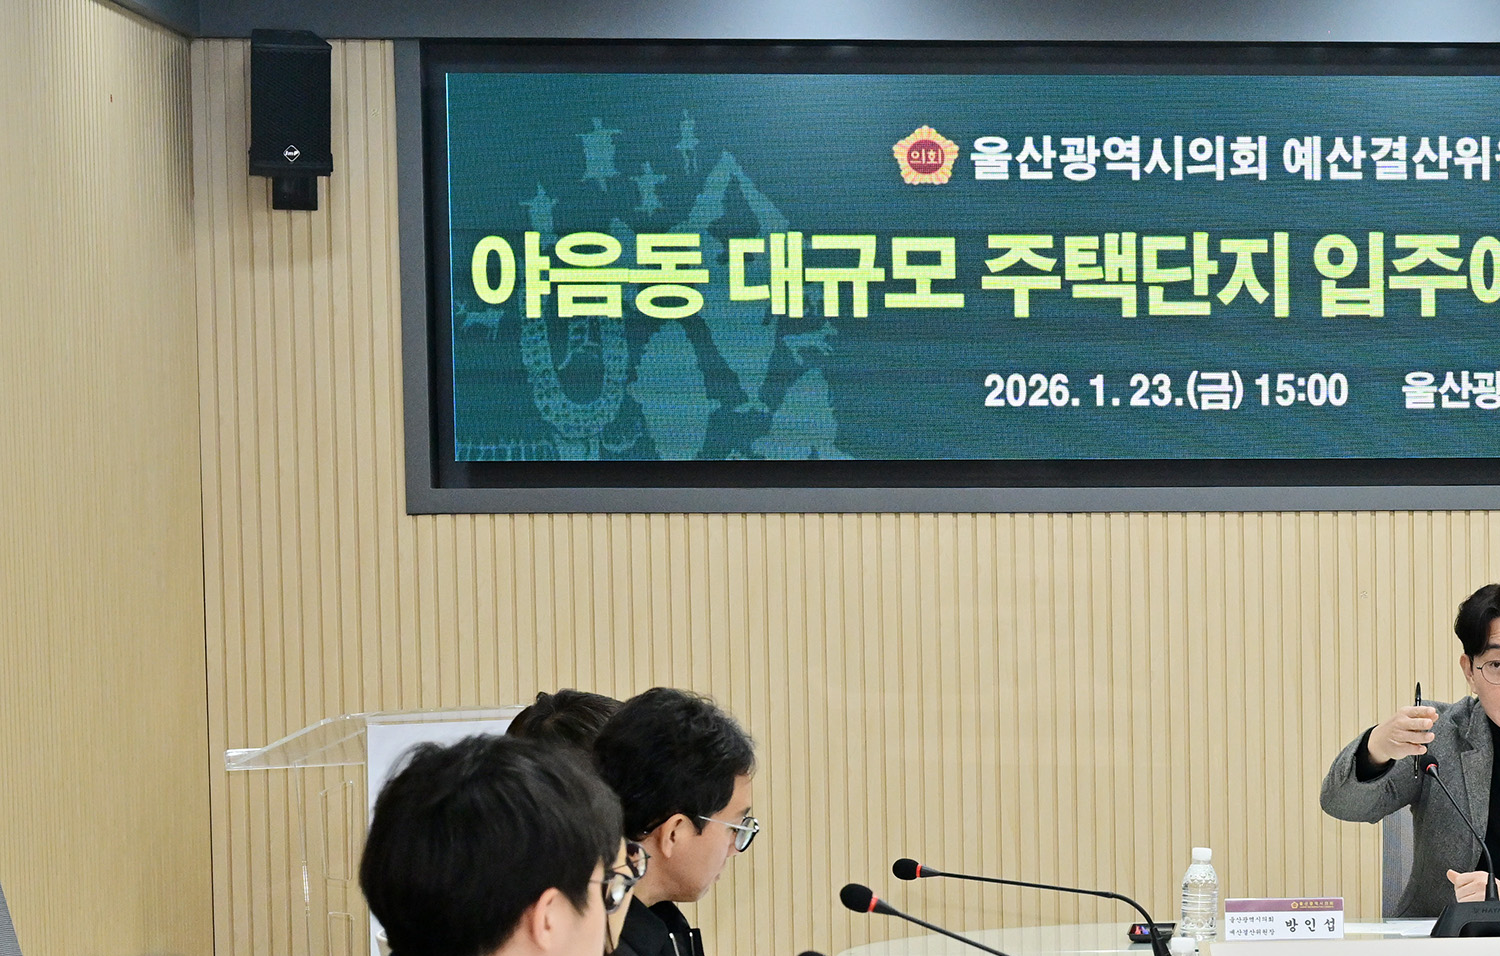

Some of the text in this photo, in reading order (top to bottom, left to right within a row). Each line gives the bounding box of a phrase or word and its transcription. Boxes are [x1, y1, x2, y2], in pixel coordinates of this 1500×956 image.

[910, 148, 942, 164] 의회
[970, 135, 1267, 181] 울산광역시의회
[471, 231, 710, 319] 야음동
[728, 231, 965, 318] 대규모
[981, 231, 1289, 318] 주택단지
[984, 371, 1349, 410] 2026. 1. 23.(금) 15:00
